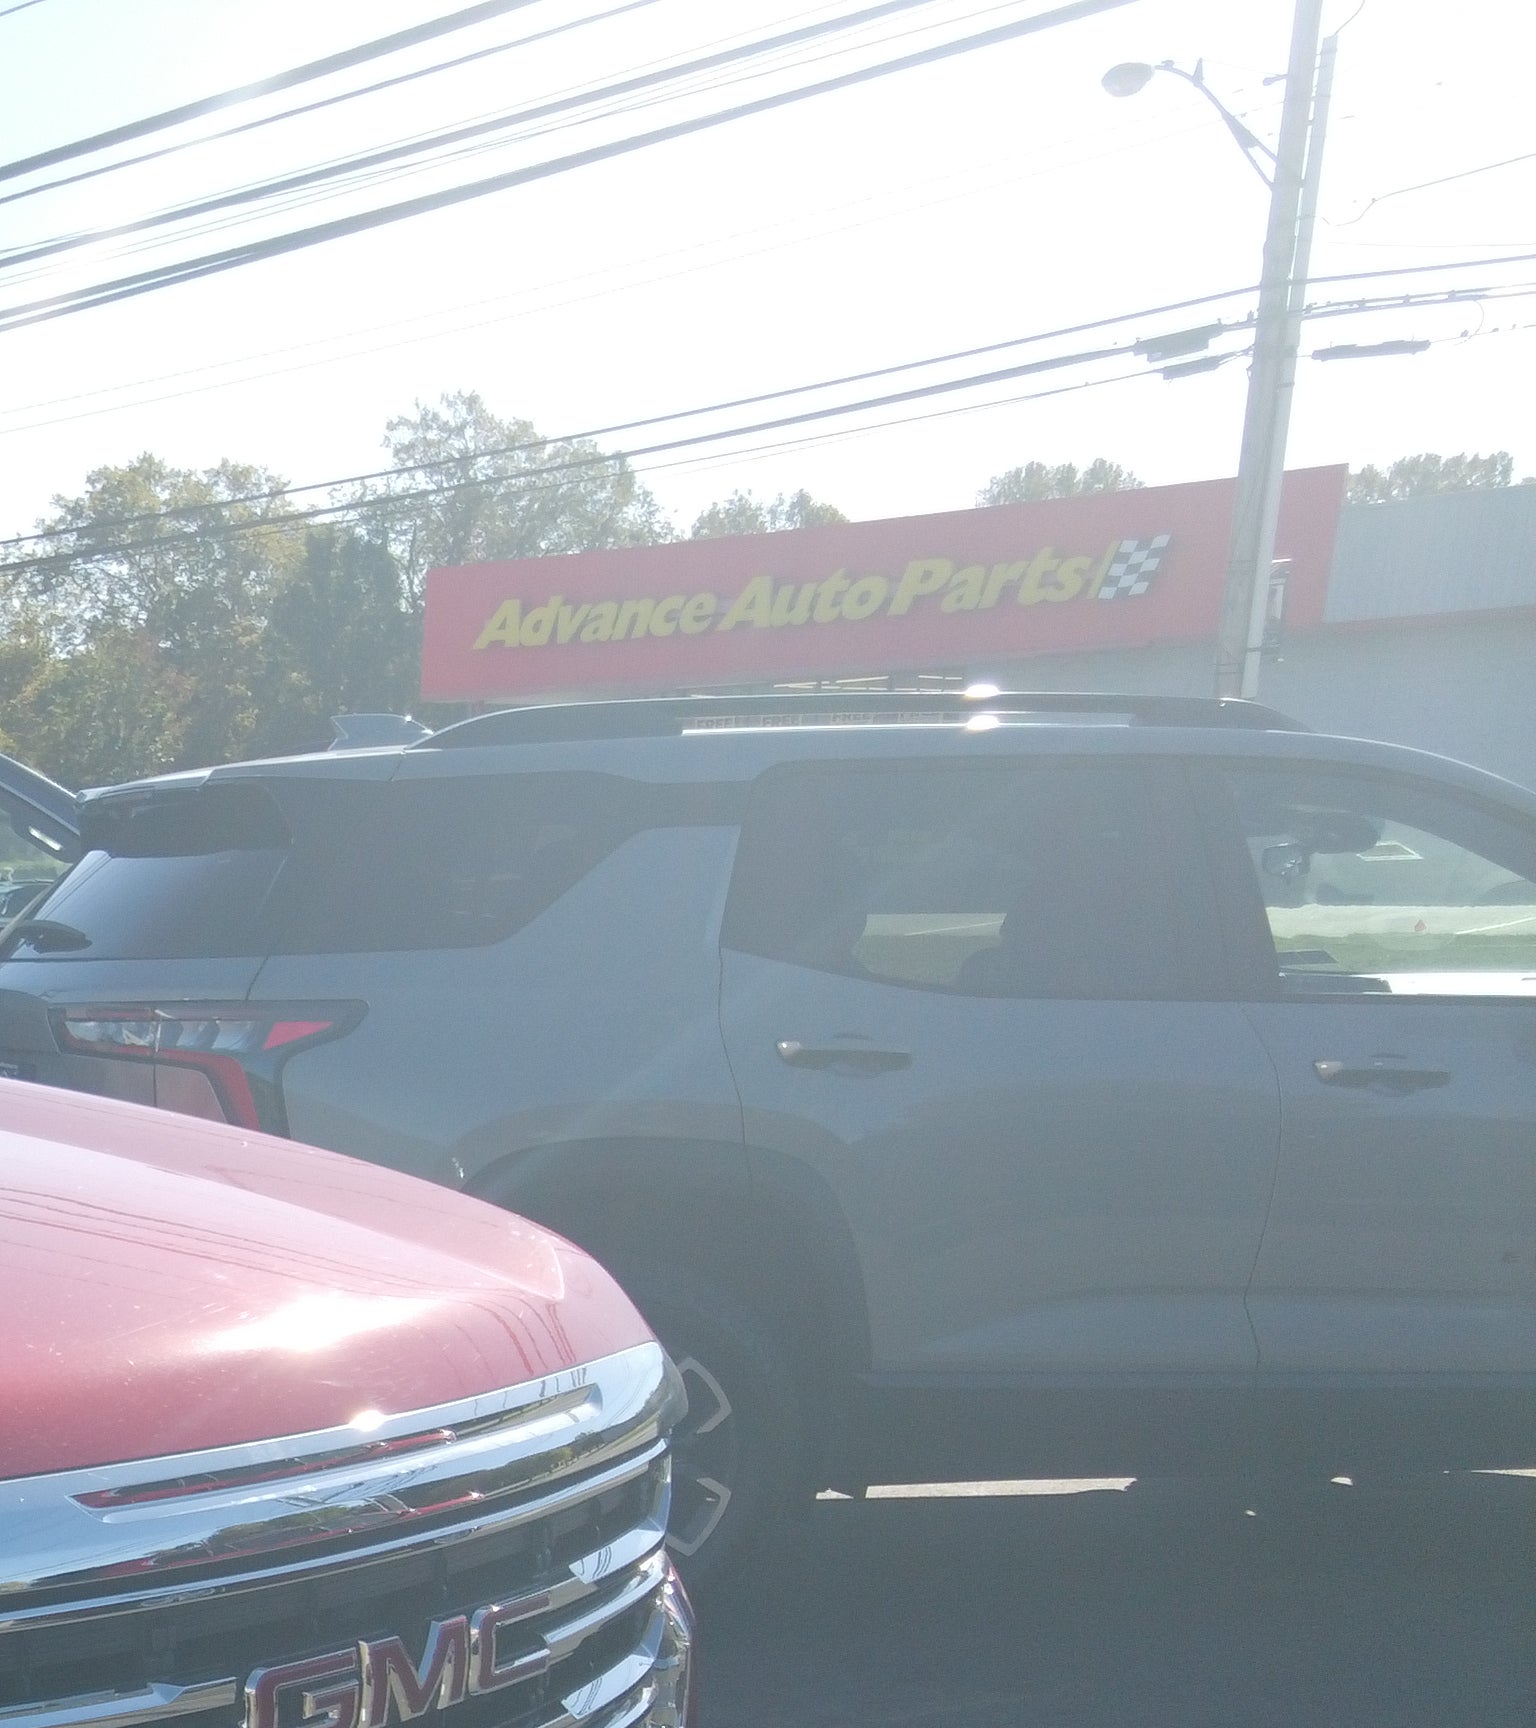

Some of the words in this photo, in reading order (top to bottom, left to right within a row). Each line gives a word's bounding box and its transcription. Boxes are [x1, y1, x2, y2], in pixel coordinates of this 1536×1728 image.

[472, 591, 718, 650] Advance
[717, 567, 888, 631] Auto
[886, 546, 1093, 616] Parts
